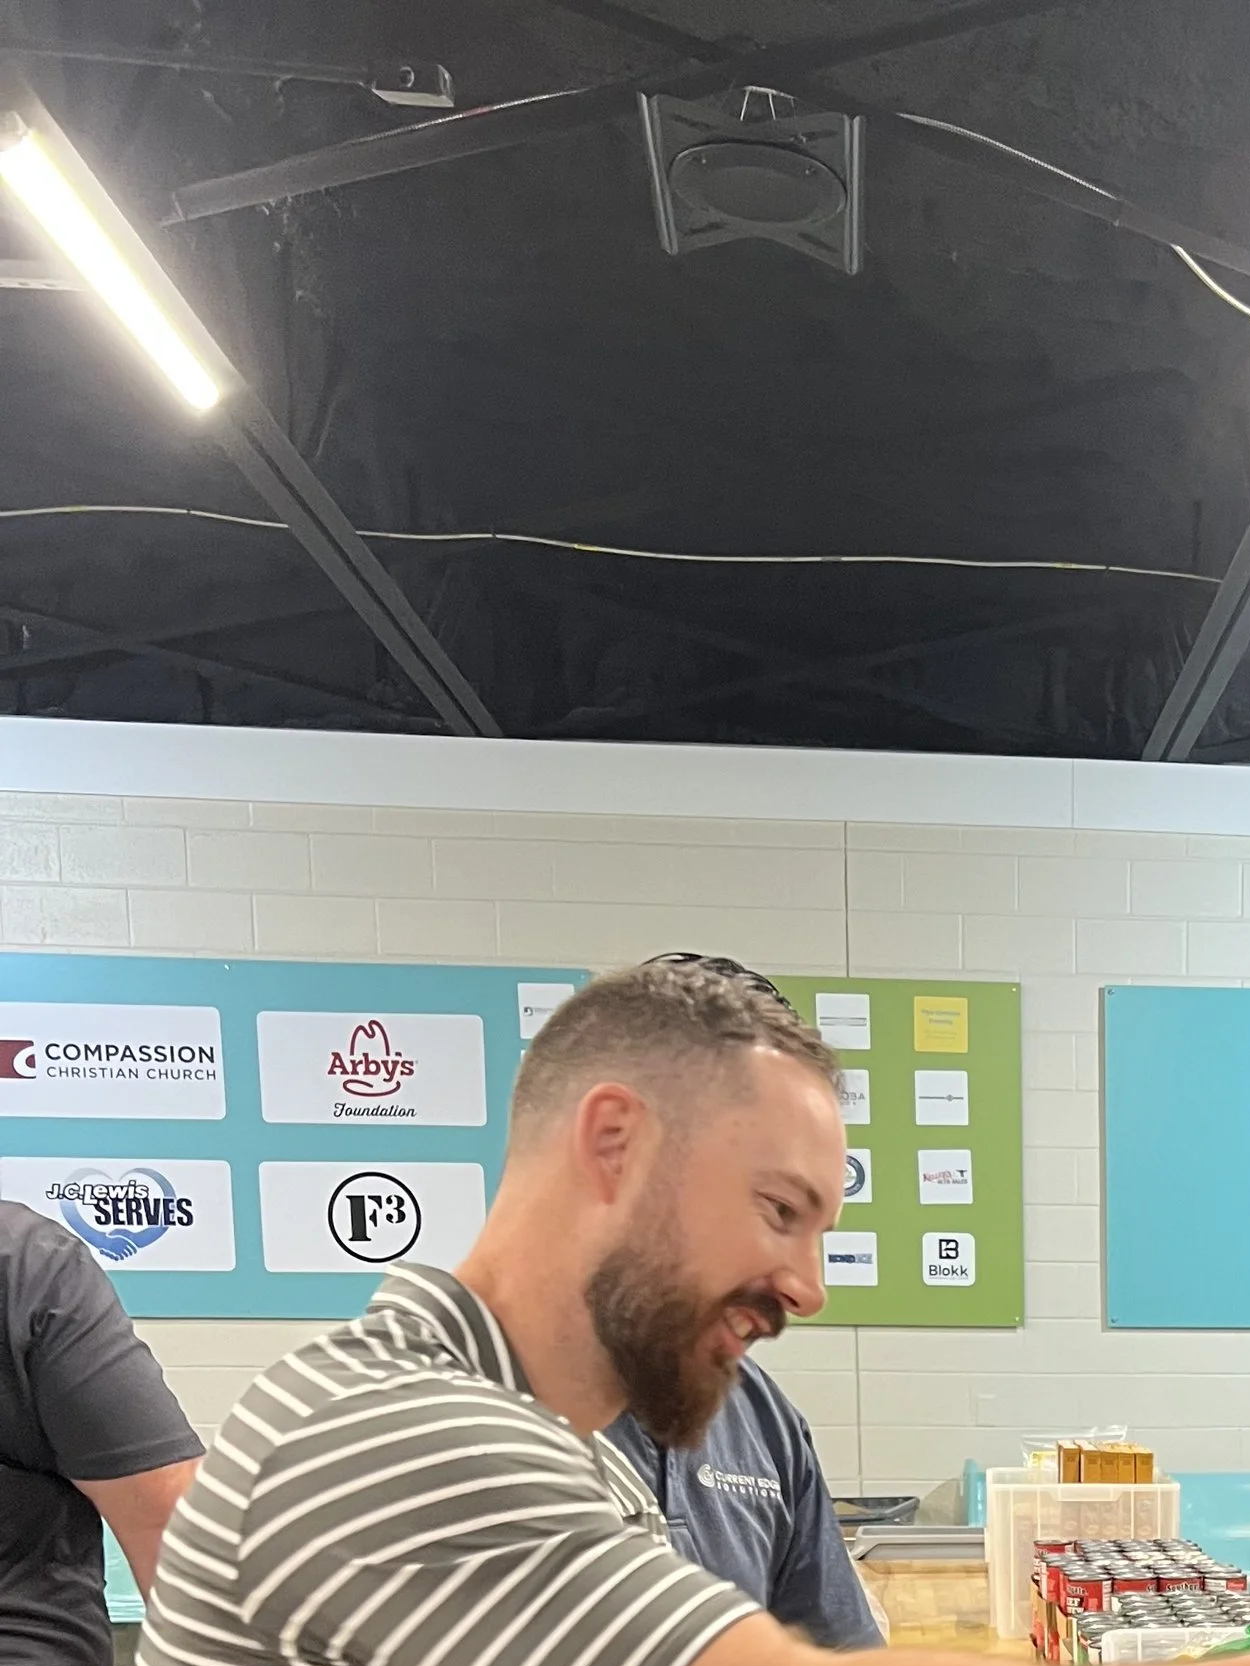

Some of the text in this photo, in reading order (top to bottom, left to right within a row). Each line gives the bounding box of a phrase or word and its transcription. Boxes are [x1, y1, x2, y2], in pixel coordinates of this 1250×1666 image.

[45, 1042, 215, 1064] COMPASSION
[46, 1066, 217, 1081] CHRISTIAN CHURCH
[327, 1051, 415, 1082] Arby's
[333, 1101, 417, 1118] Foundation
[94, 1197, 194, 1228] SERVES
[929, 1264, 968, 1277] Blokk
